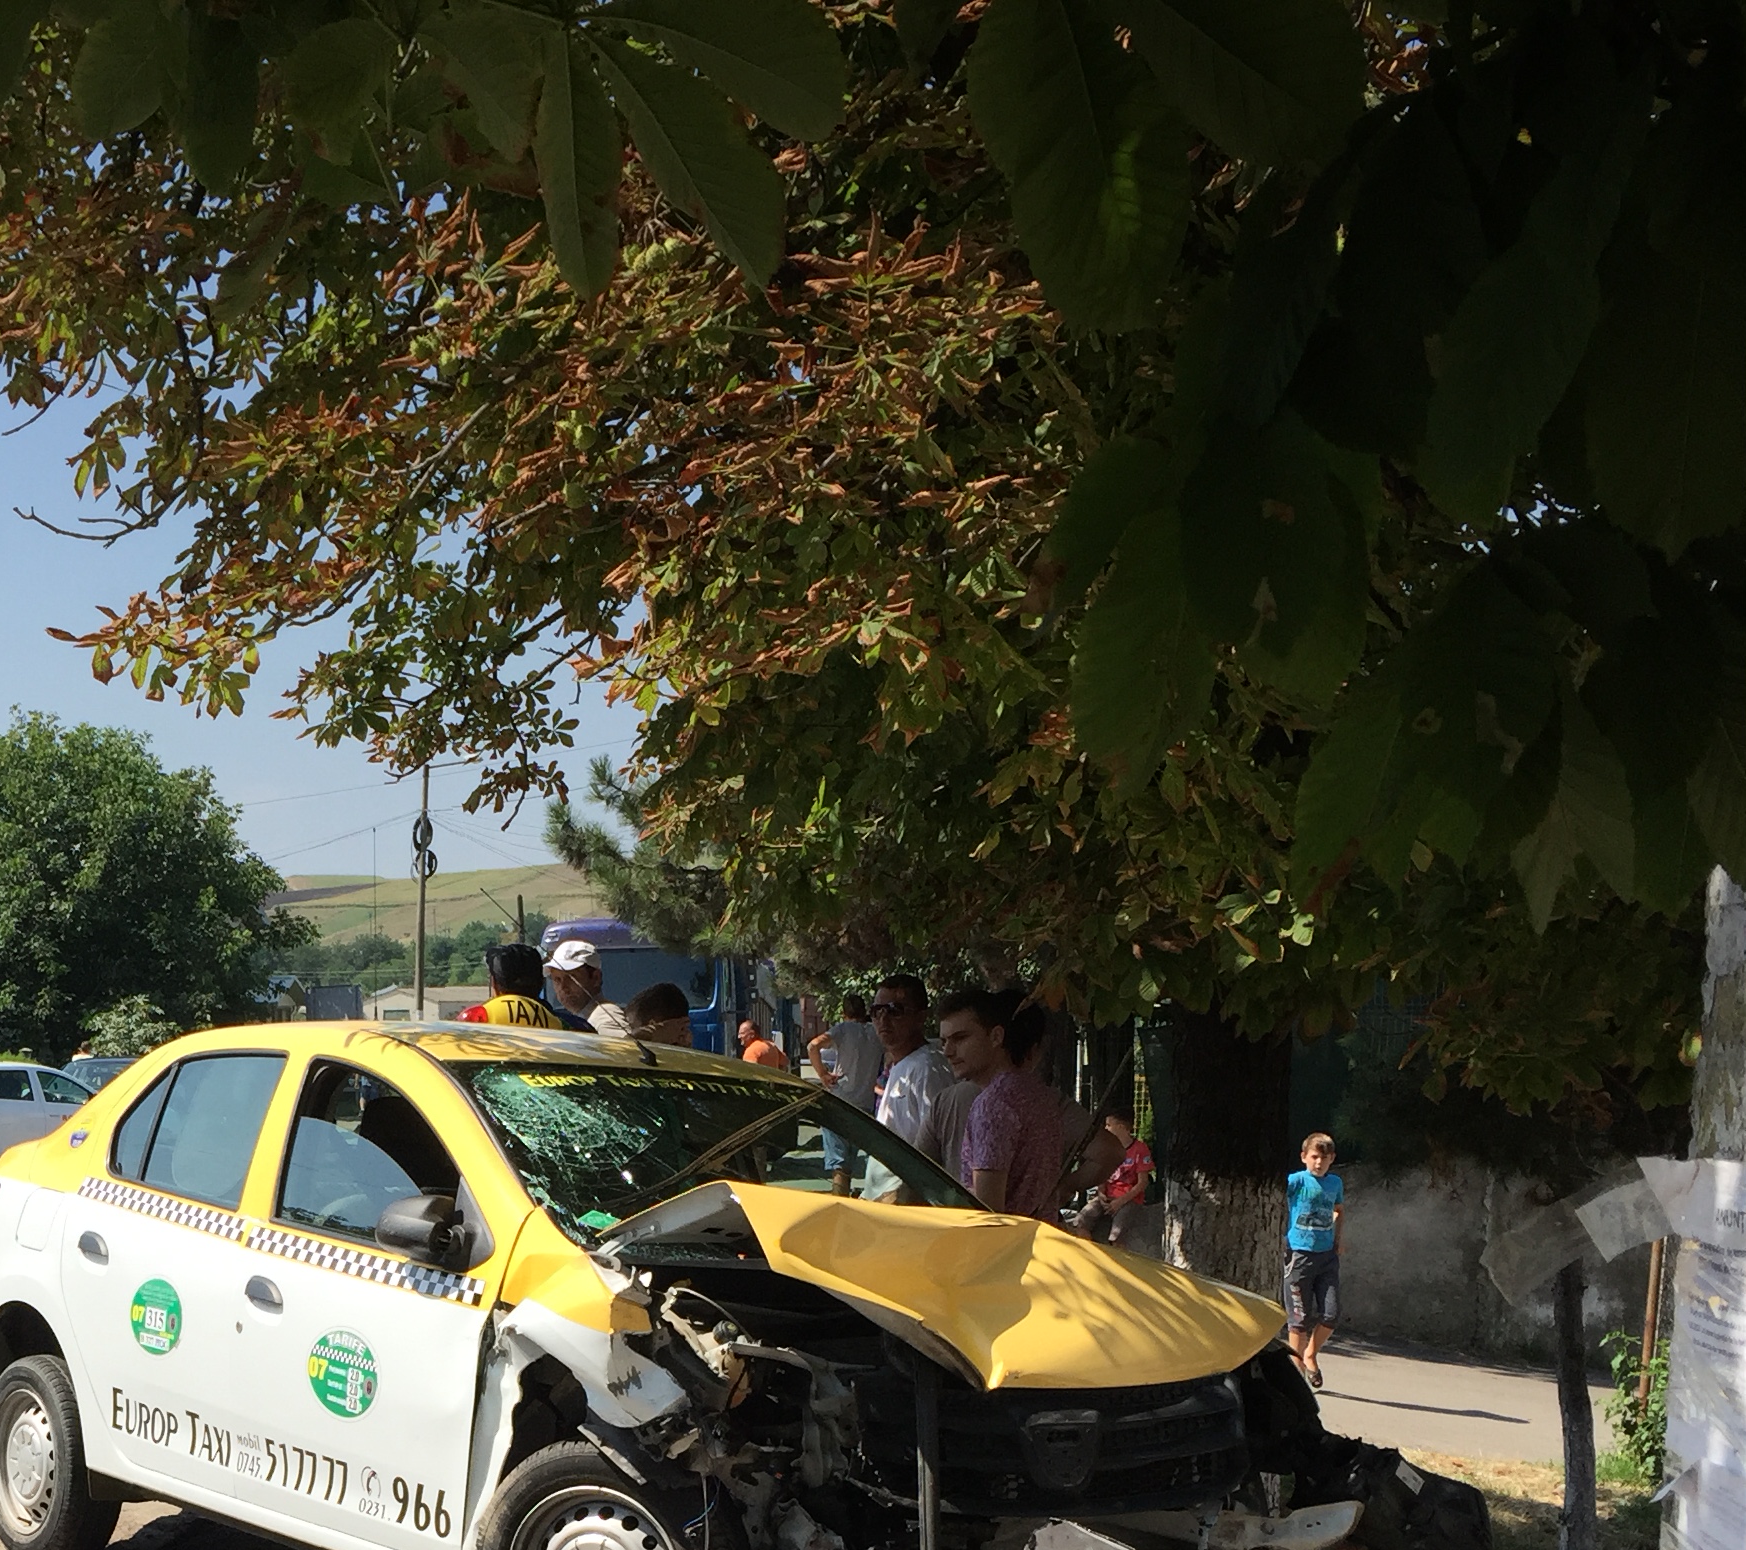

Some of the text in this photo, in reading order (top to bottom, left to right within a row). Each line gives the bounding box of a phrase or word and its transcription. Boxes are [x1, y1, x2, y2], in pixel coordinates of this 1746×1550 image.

[504, 1000, 549, 1029] TAXI
[518, 1072, 597, 1088] EUROP
[598, 1074, 654, 1088] TAXI
[132, 1304, 164, 1329] 07 315
[327, 1333, 366, 1356] TARIFE
[309, 1356, 329, 1380] 07
[112, 1386, 232, 1468] EUROP TAXI
[237, 1433, 261, 1452] mobil
[392, 1476, 451, 1539] 966
